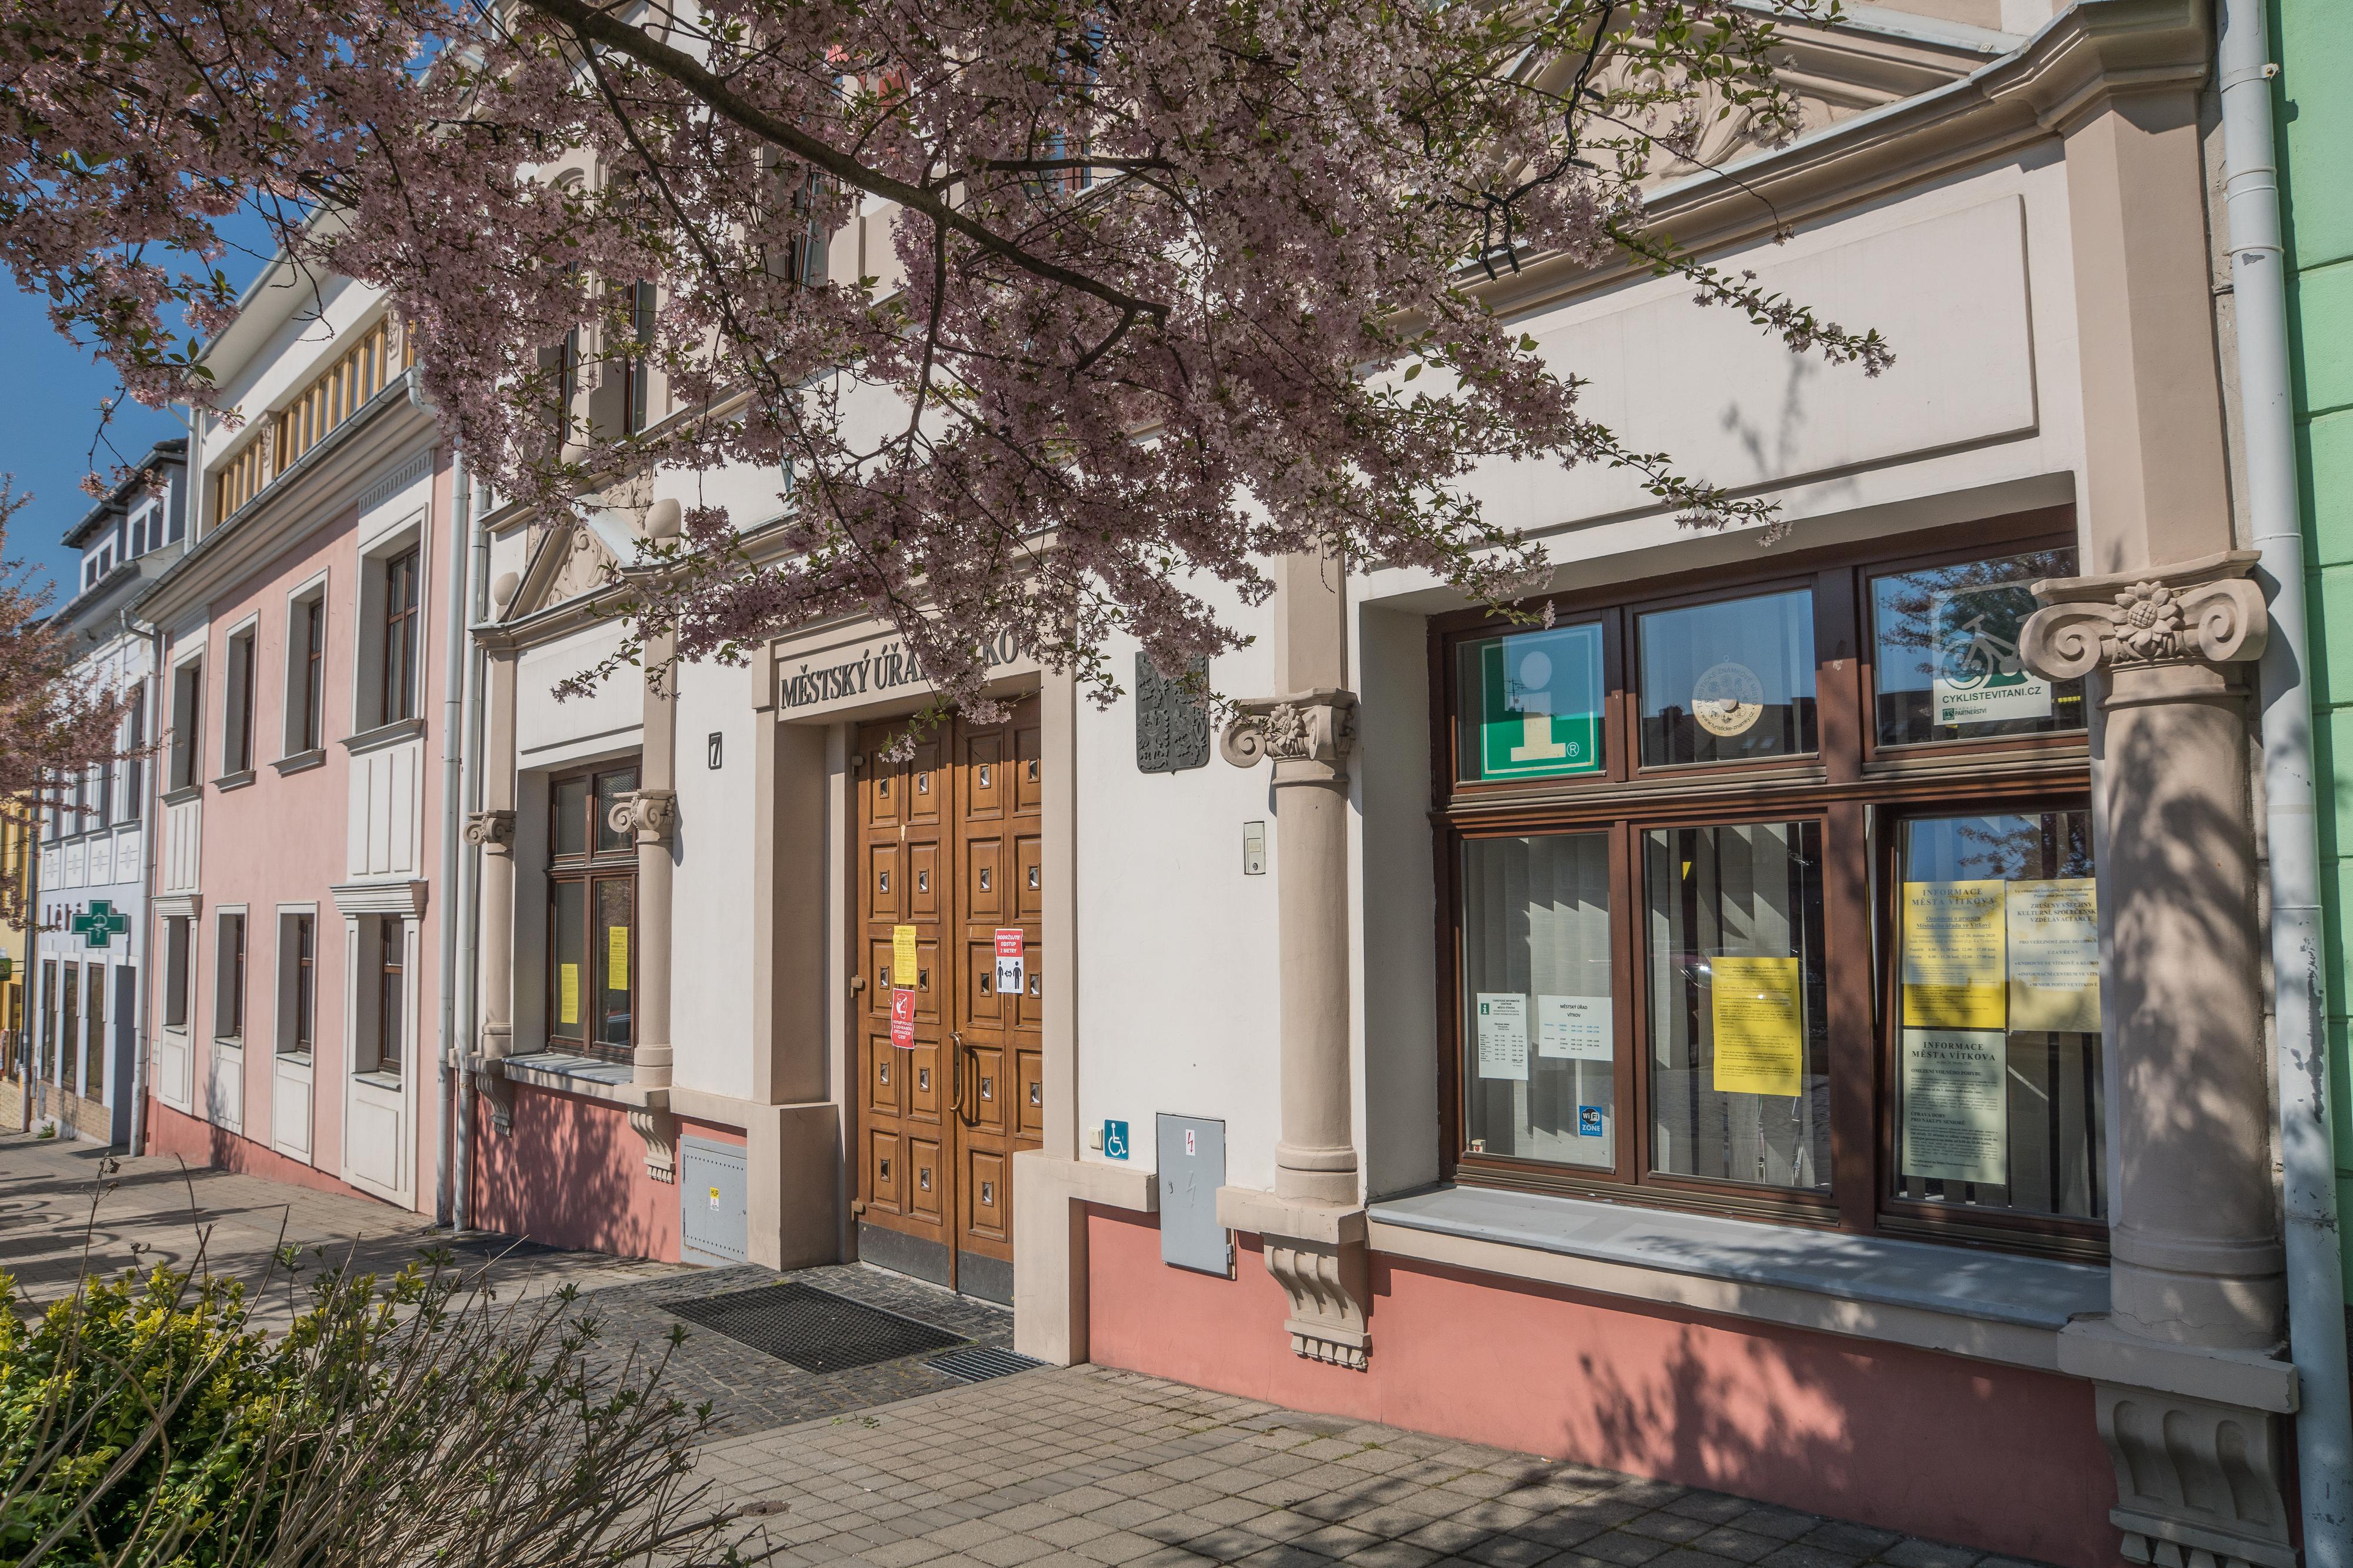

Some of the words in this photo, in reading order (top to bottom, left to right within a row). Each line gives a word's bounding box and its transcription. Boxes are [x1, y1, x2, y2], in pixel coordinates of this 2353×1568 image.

[781, 649, 871, 709] MĚSTSKÝ
[874, 642, 926, 690] ÚŘA
[1942, 687, 2042, 703] CYKLISTEVITANI.CZ
[1702, 712, 1754, 731] www.turisticke-znamky.cz
[711, 736, 720, 765] 7
[1949, 896, 1994, 905] VÍTKOVA
[1924, 1042, 1984, 1050] INFORMACE
[1912, 1050, 1945, 1058] MĚSTA
[1949, 1051, 1995, 1060] VÍTKOVA
